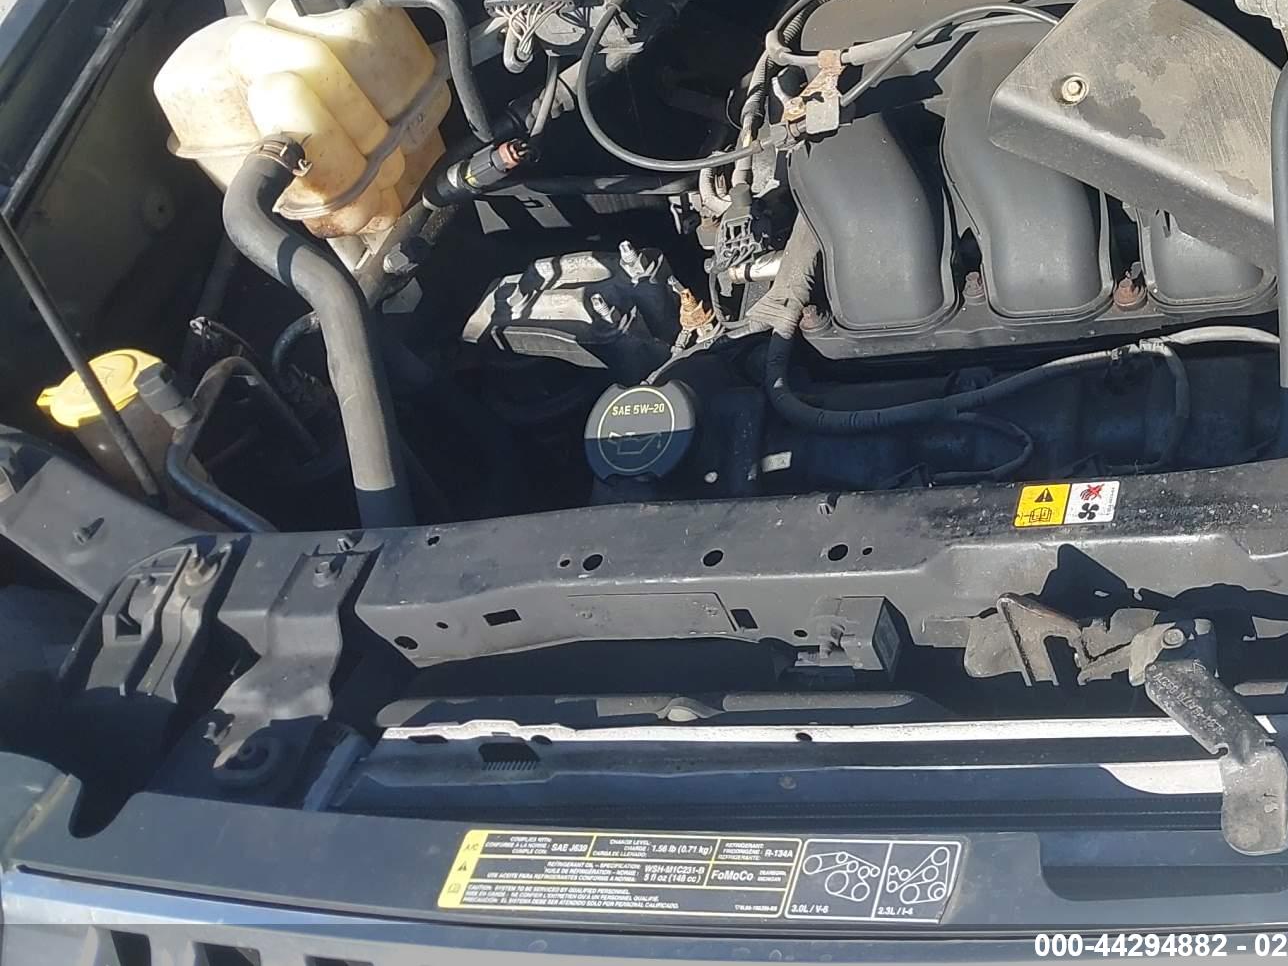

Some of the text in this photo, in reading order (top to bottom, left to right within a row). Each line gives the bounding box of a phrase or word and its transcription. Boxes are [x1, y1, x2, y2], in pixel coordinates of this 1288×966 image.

[611, 403, 665, 416] SAE 5W-20
[550, 843, 588, 852] SAE J639
[698, 845, 713, 855] kg)
[764, 849, 793, 858] R-134A
[710, 869, 754, 881] FoMoCo
[791, 904, 809, 913] 3.0L
[877, 906, 895, 915] 2.3L
